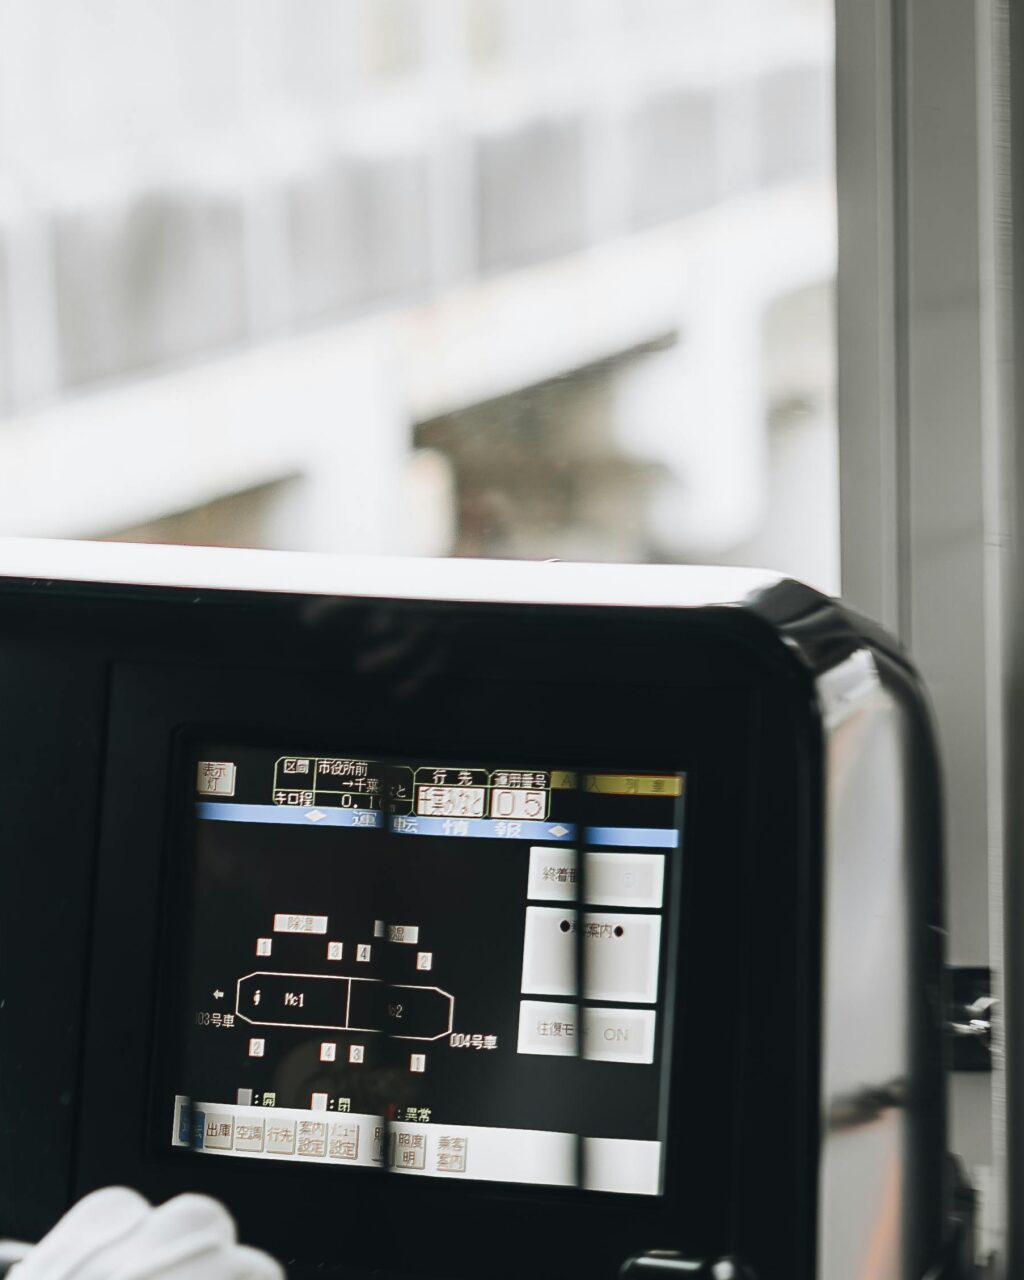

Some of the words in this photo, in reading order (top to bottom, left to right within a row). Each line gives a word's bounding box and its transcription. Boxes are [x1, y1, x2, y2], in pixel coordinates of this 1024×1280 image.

[283, 759, 310, 774] 区間
[318, 760, 368, 777] 市役所前
[354, 777, 407, 798] 千葉と
[275, 791, 314, 807] キロ程
[496, 791, 543, 817] 05
[196, 1011, 235, 1028] 03号車
[449, 1033, 498, 1050] 004号車
[603, 1027, 630, 1042] ON
[206, 1122, 231, 1138] 出庫
[235, 1125, 263, 1141] 空調
[266, 1127, 293, 1143] 行先
[398, 1133, 424, 1149] 照度
[402, 1151, 416, 1165] 明
